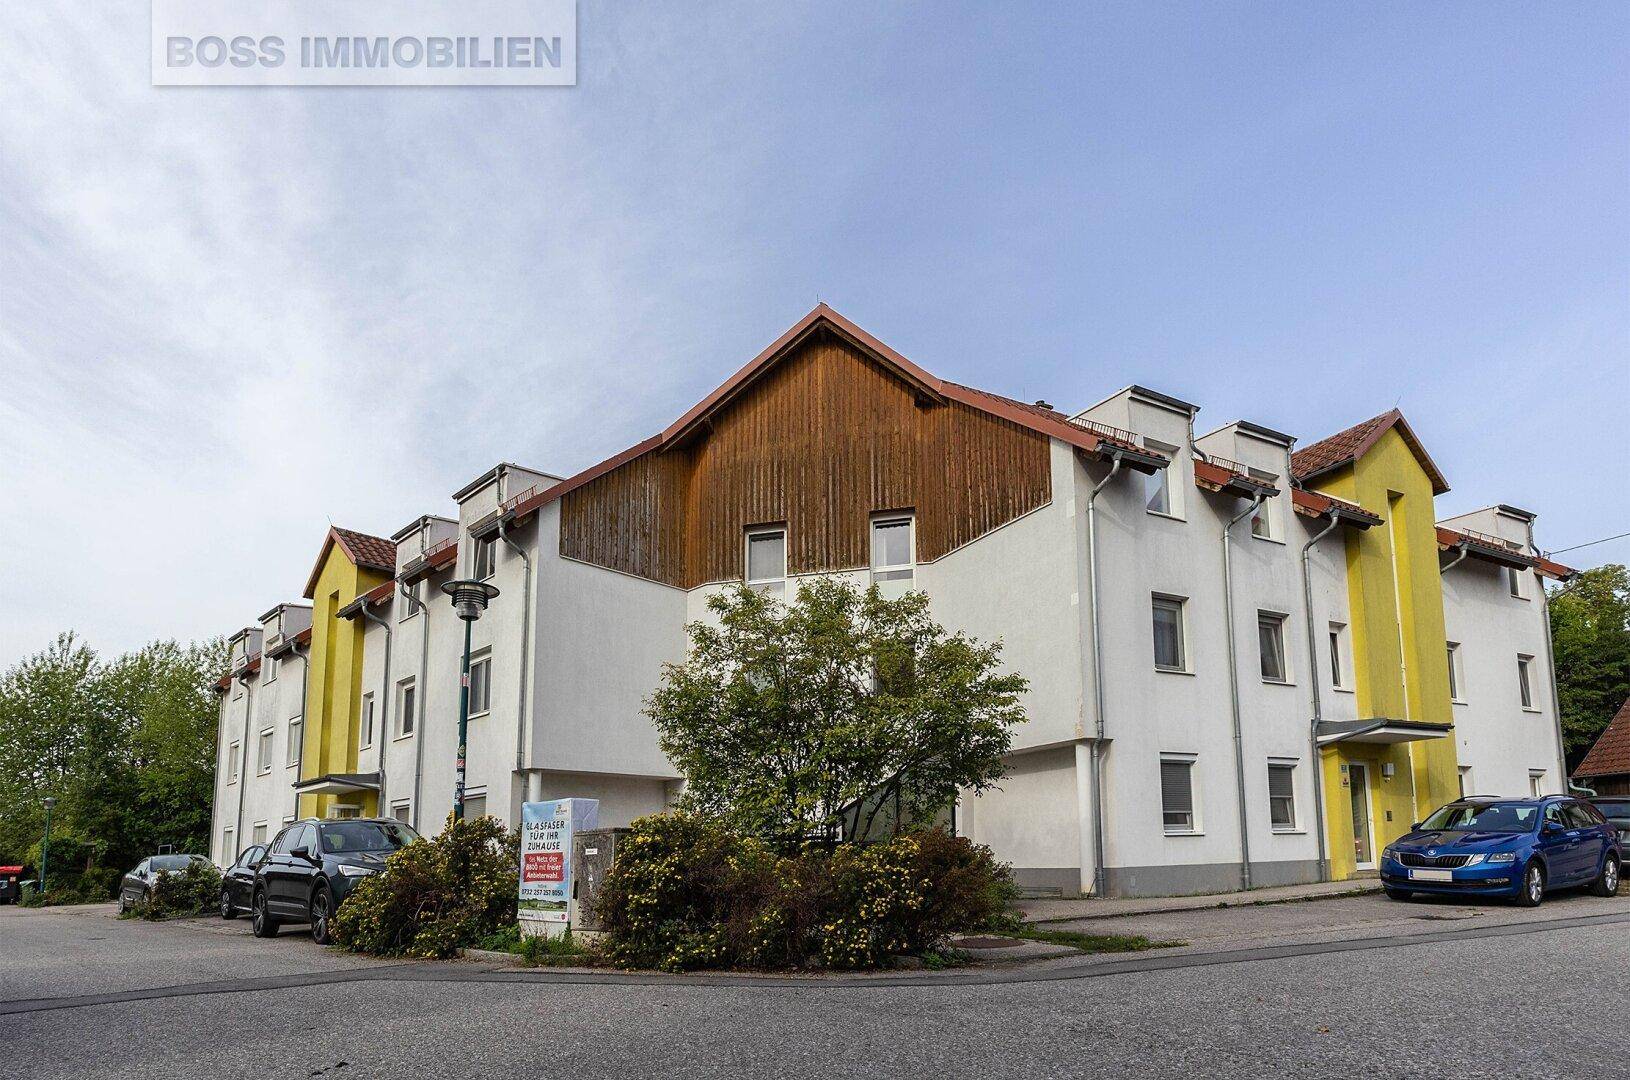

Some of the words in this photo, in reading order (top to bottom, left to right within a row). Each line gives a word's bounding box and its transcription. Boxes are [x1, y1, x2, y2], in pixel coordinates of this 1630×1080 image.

[526, 820, 565, 831] GLASFASER
[529, 831, 545, 841] FÜR
[546, 831, 559, 841] IHR
[527, 841, 560, 851] ZUHAUSE
